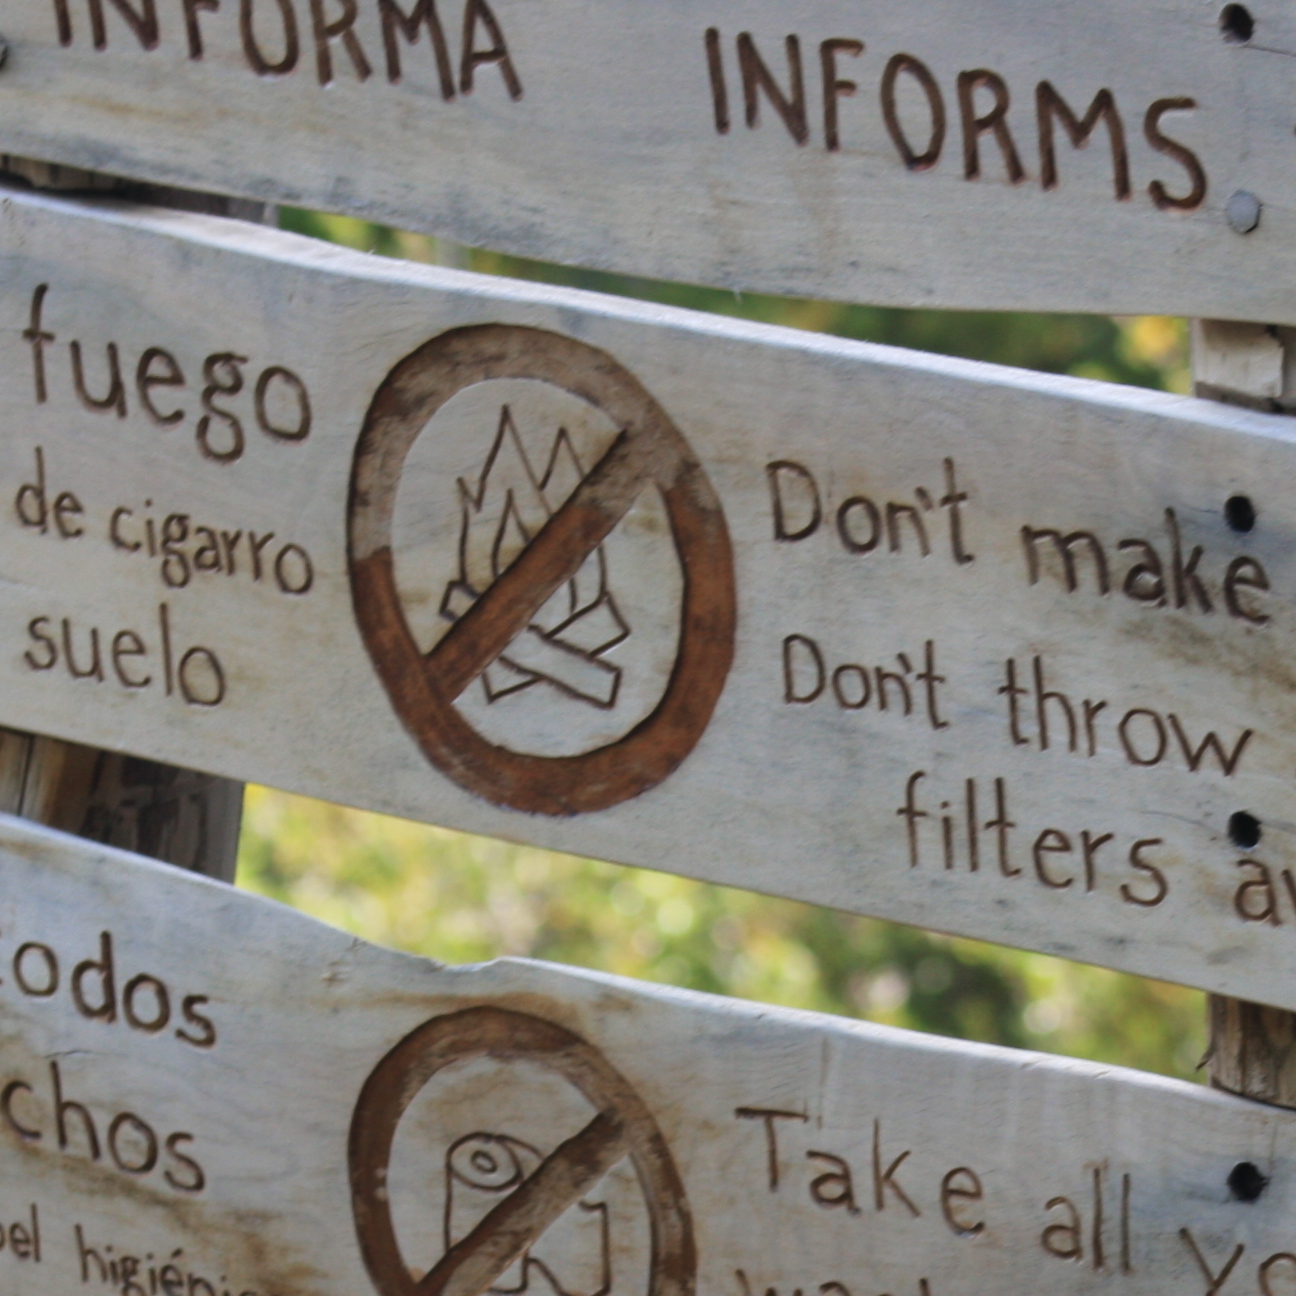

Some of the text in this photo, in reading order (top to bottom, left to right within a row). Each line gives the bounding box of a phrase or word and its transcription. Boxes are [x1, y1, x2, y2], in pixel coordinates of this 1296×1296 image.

[704, 25, 1208, 211] INFORMS
[23, 283, 313, 464] fuego
[15, 447, 85, 540] de
[110, 500, 315, 596] cigarro
[765, 456, 974, 565] Don't
[1020, 508, 1272, 626] make
[23, 603, 227, 707] suelo
[782, 633, 950, 730] Don't
[997, 654, 1254, 777] throw
[896, 770, 1169, 907] filters
[735, 1108, 986, 1236] Take
[1040, 1166, 1132, 1275] all
